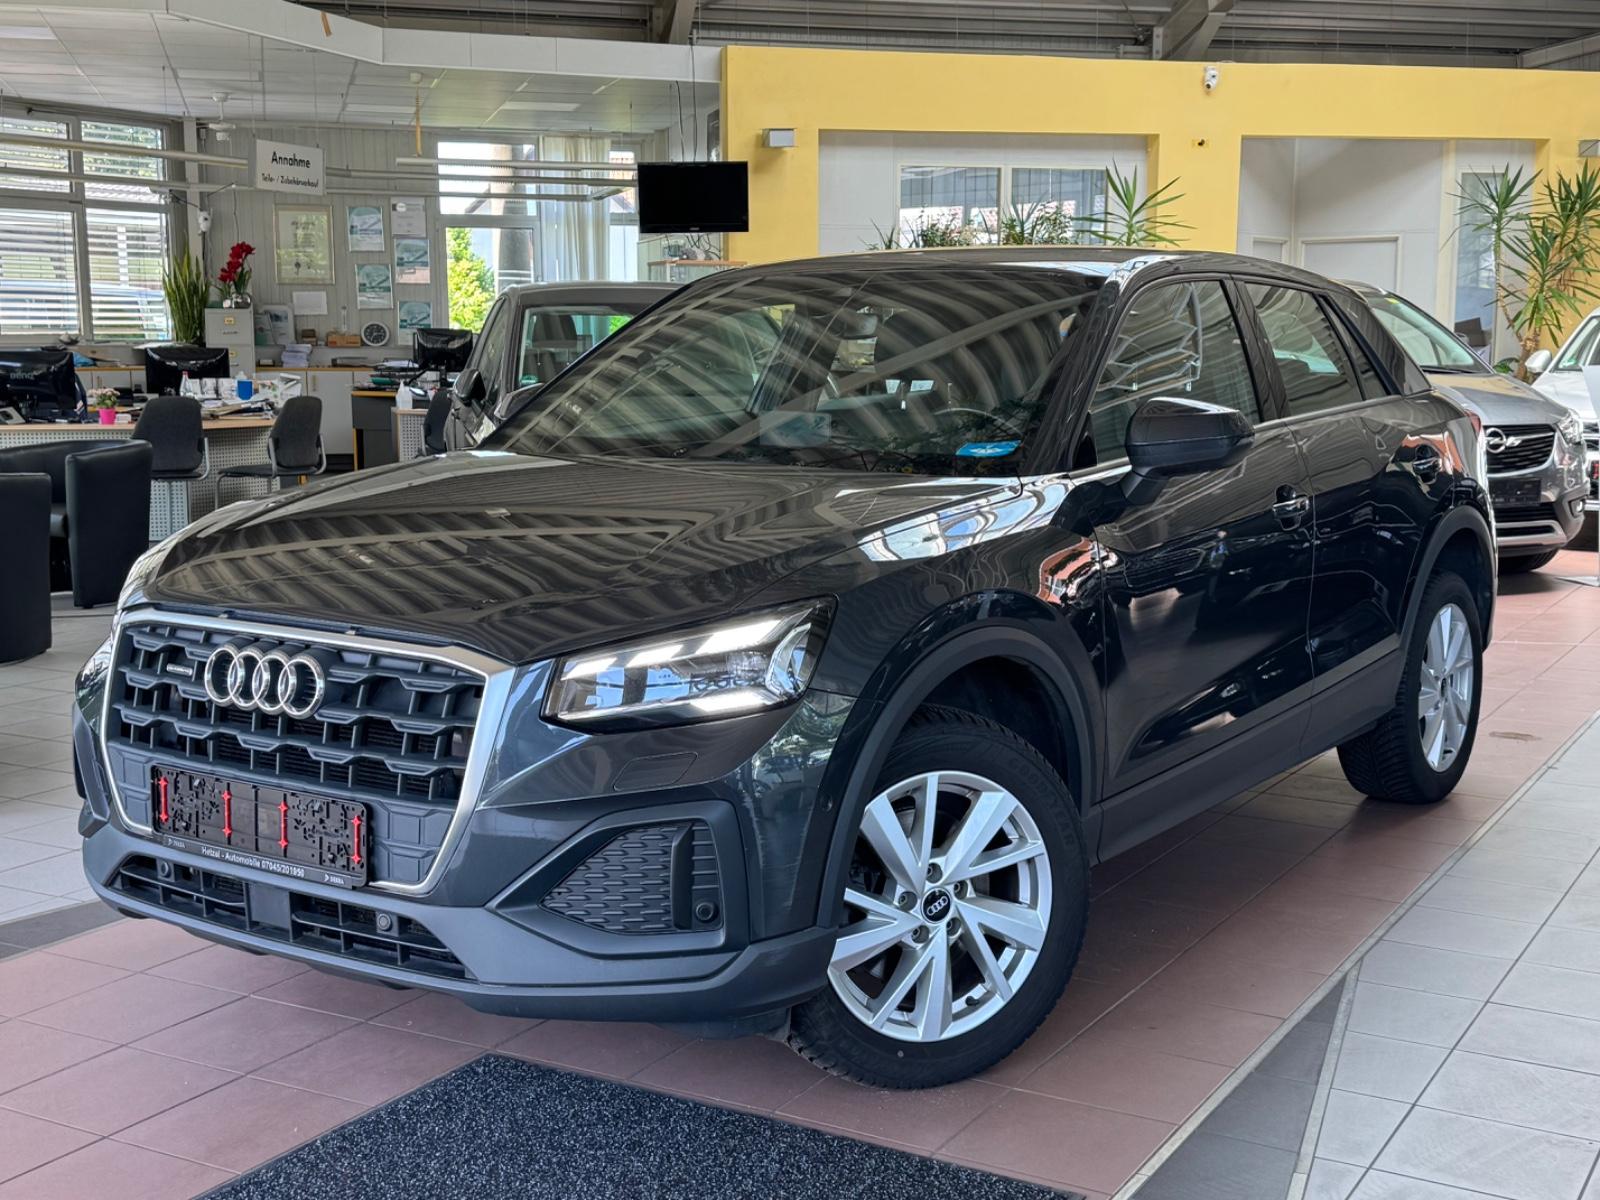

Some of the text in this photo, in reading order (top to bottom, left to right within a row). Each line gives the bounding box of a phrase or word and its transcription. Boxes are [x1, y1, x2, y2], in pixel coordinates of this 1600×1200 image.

[271, 151, 311, 168] Annahme
[1008, 757, 1076, 846] GOODYEAR
[224, 852, 260, 868] Automobile
